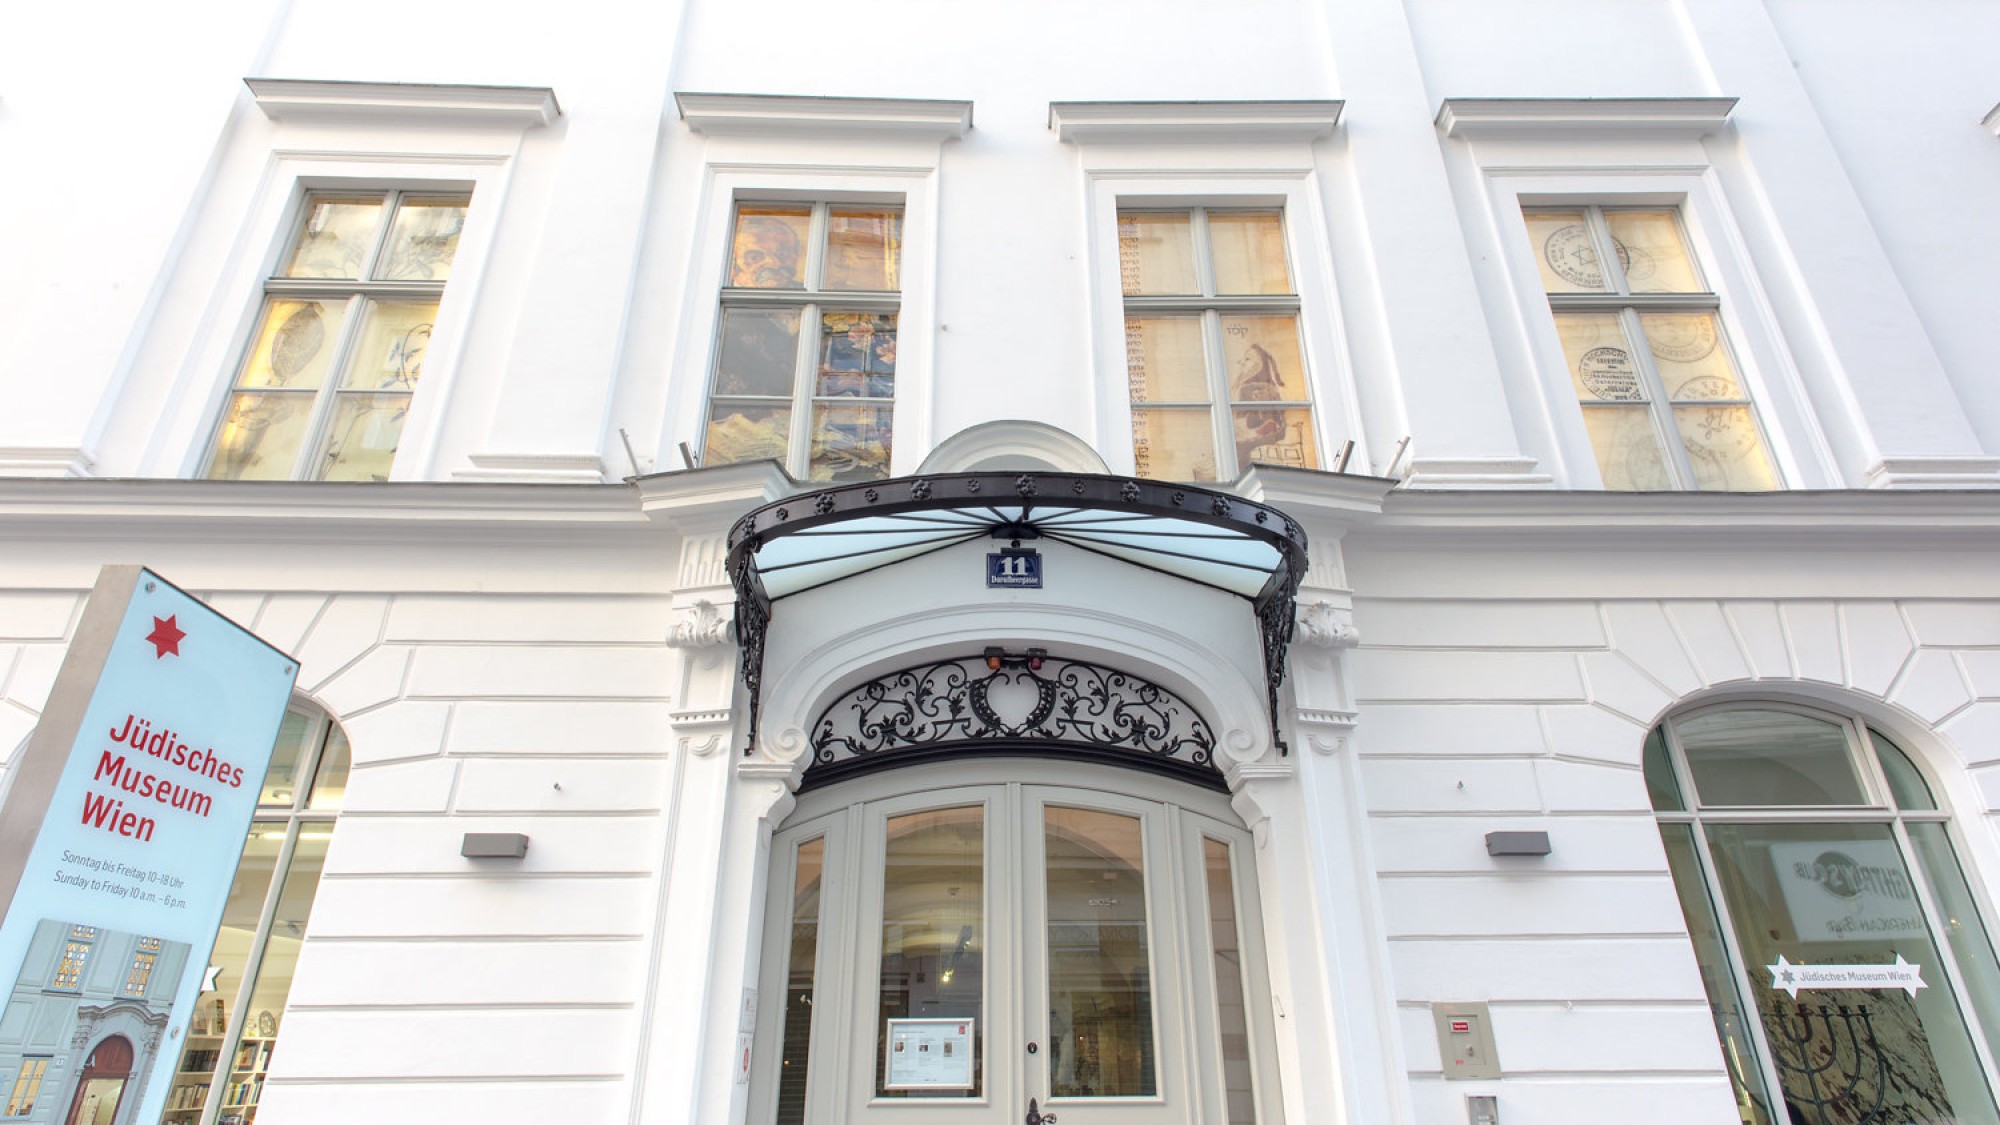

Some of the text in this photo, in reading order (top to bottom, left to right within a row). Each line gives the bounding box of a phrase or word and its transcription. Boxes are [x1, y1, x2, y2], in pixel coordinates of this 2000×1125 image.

[1001, 557, 1028, 575] 11
[110, 714, 244, 788] Jüdisches
[94, 750, 213, 817] Museum
[81, 791, 156, 842] Wien
[54, 870, 90, 890] Sunday
[91, 880, 101, 890] to
[102, 880, 129, 898] Friday
[130, 887, 140, 899] 10
[164, 894, 171, 906] 6
[62, 849, 101, 870] Sonntag
[102, 859, 116, 873] bis
[116, 863, 146, 881] Freitag
[170, 877, 185, 888] Uhr
[1800, 971, 1912, 981] Jüdisches Museum Wien
